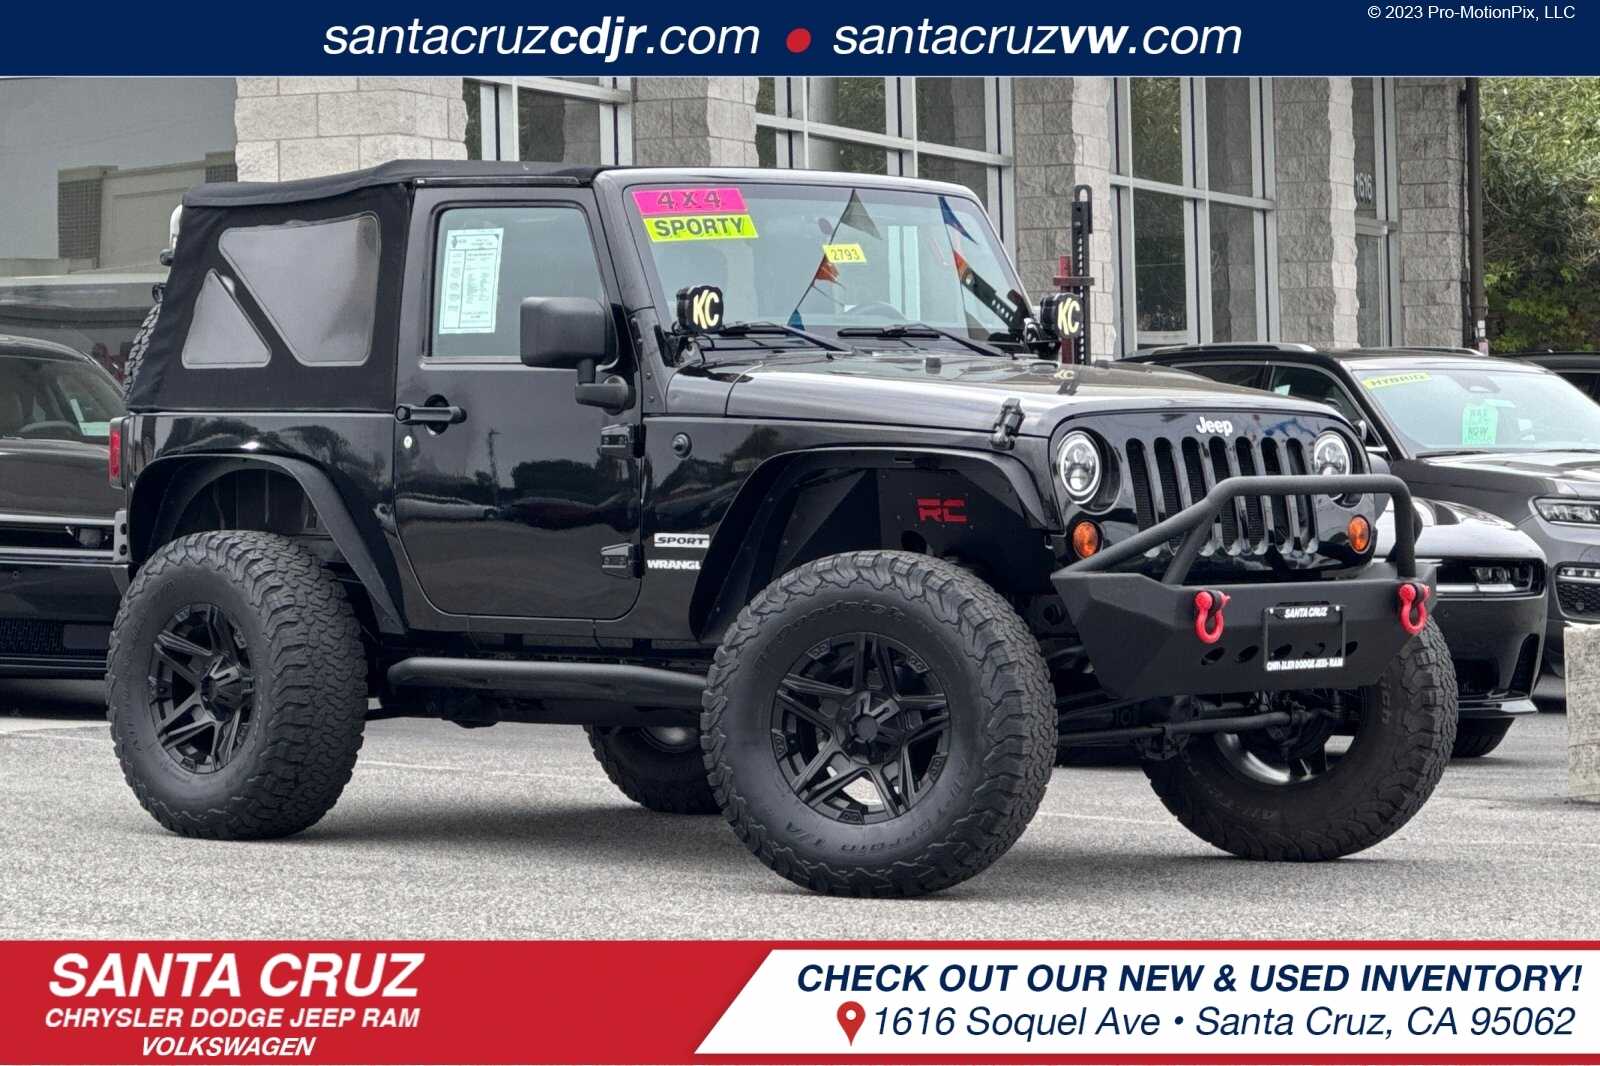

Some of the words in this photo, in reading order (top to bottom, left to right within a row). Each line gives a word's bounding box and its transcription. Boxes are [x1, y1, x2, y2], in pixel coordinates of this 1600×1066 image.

[653, 217, 745, 237] SPORTY
[830, 248, 861, 261] 2793
[692, 289, 720, 330] KC
[1057, 297, 1081, 335] KC
[1195, 416, 1233, 437] Jeep
[917, 498, 967, 522] RC
[657, 536, 709, 545] SPORT
[646, 559, 702, 571] WRANGL
[1284, 607, 1308, 618] SANTA
[1308, 606, 1329, 617] CRUZ
